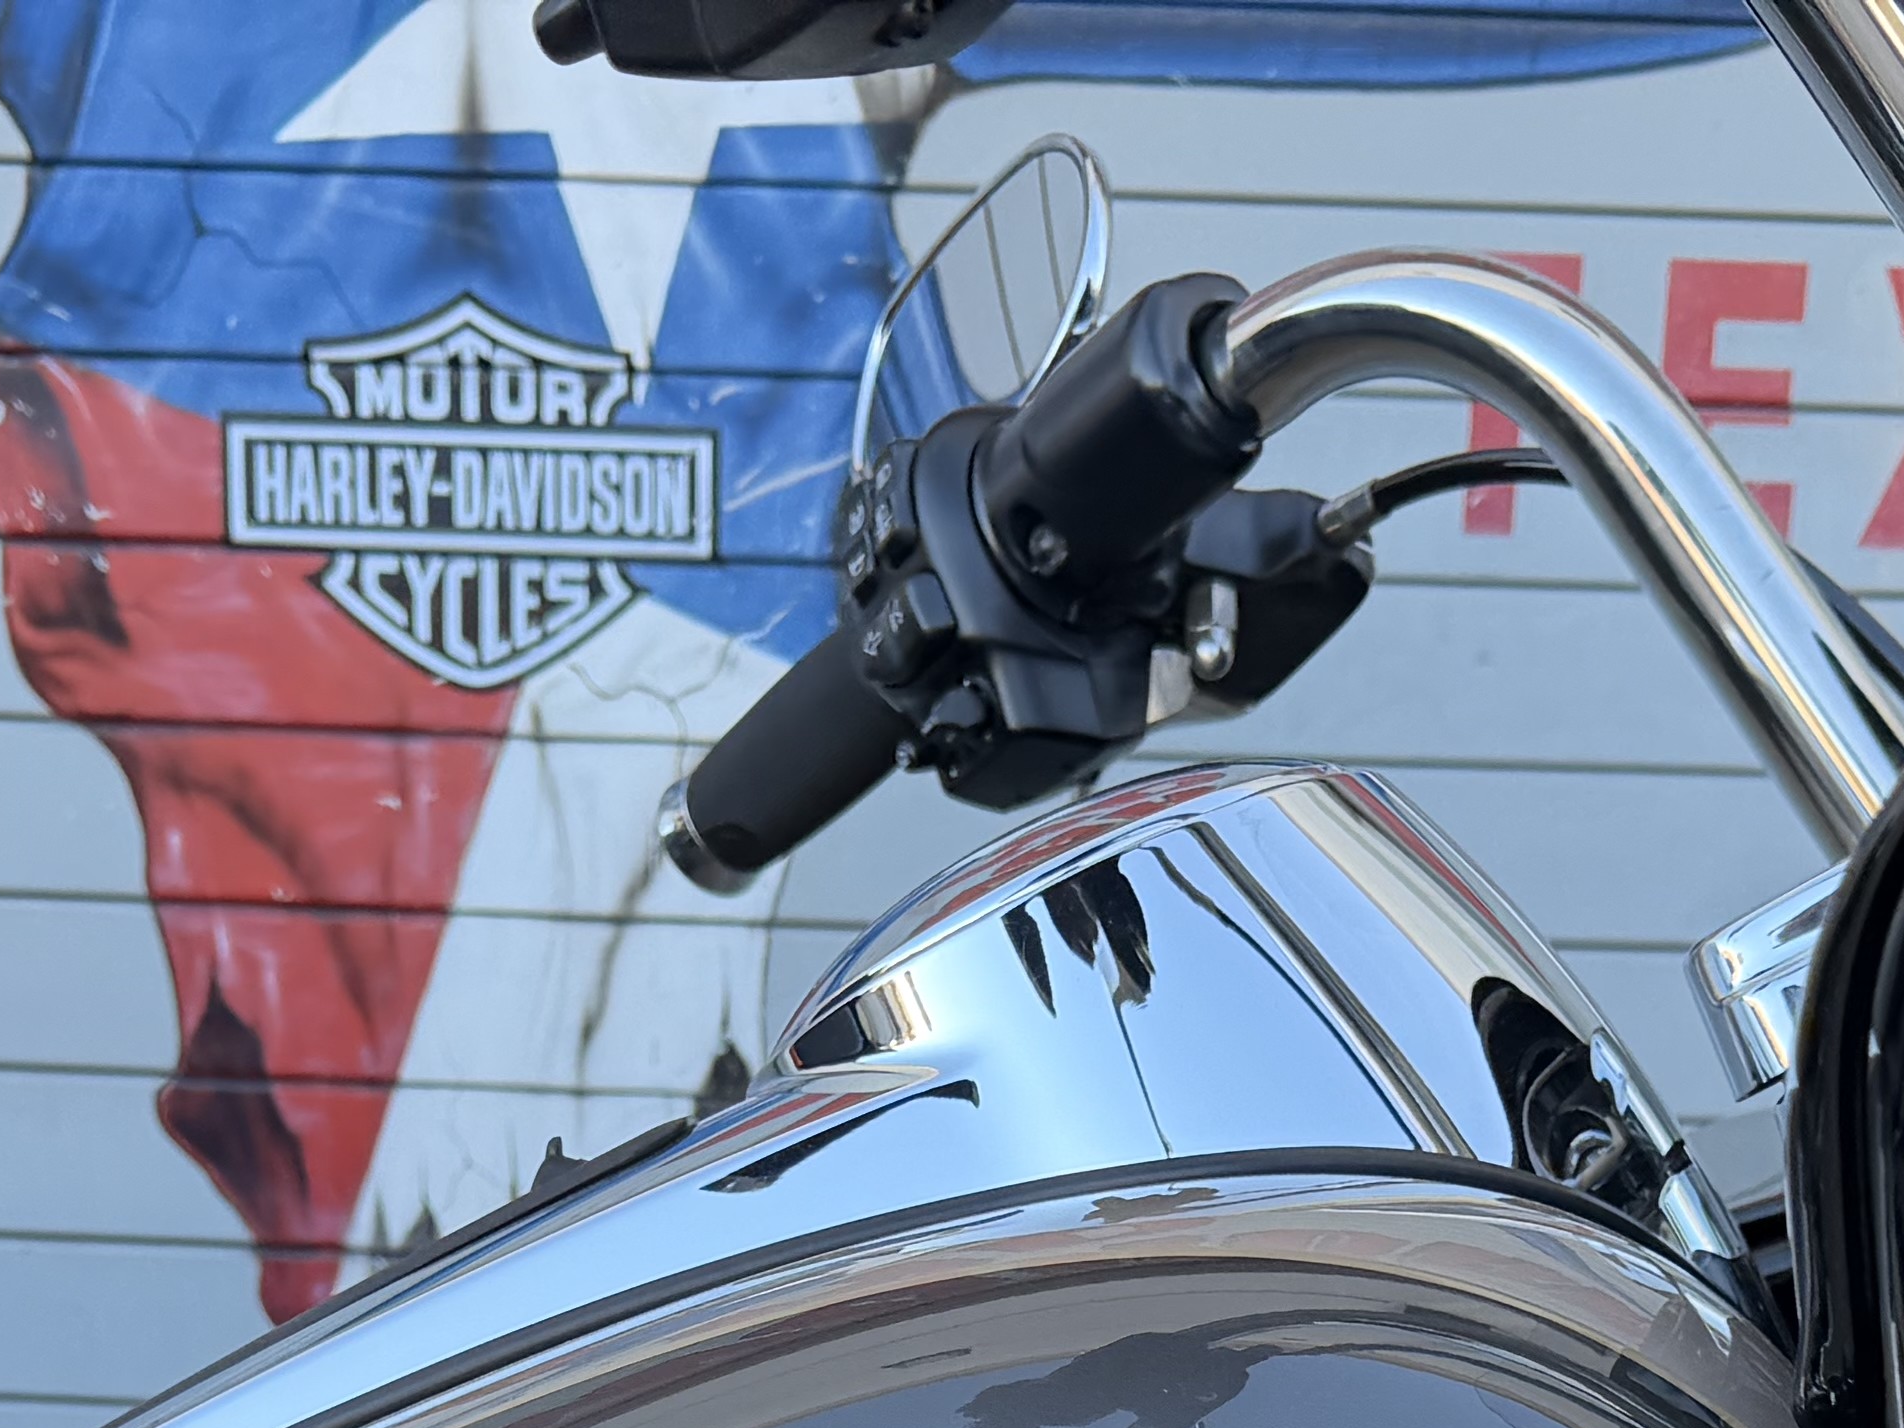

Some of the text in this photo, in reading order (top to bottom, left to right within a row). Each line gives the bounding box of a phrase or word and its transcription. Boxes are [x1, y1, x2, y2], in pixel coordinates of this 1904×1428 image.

[355, 324, 587, 424] MOTOR
[253, 442, 691, 538] HARLEY-DAVIDSON
[360, 552, 592, 668] CYCLES
